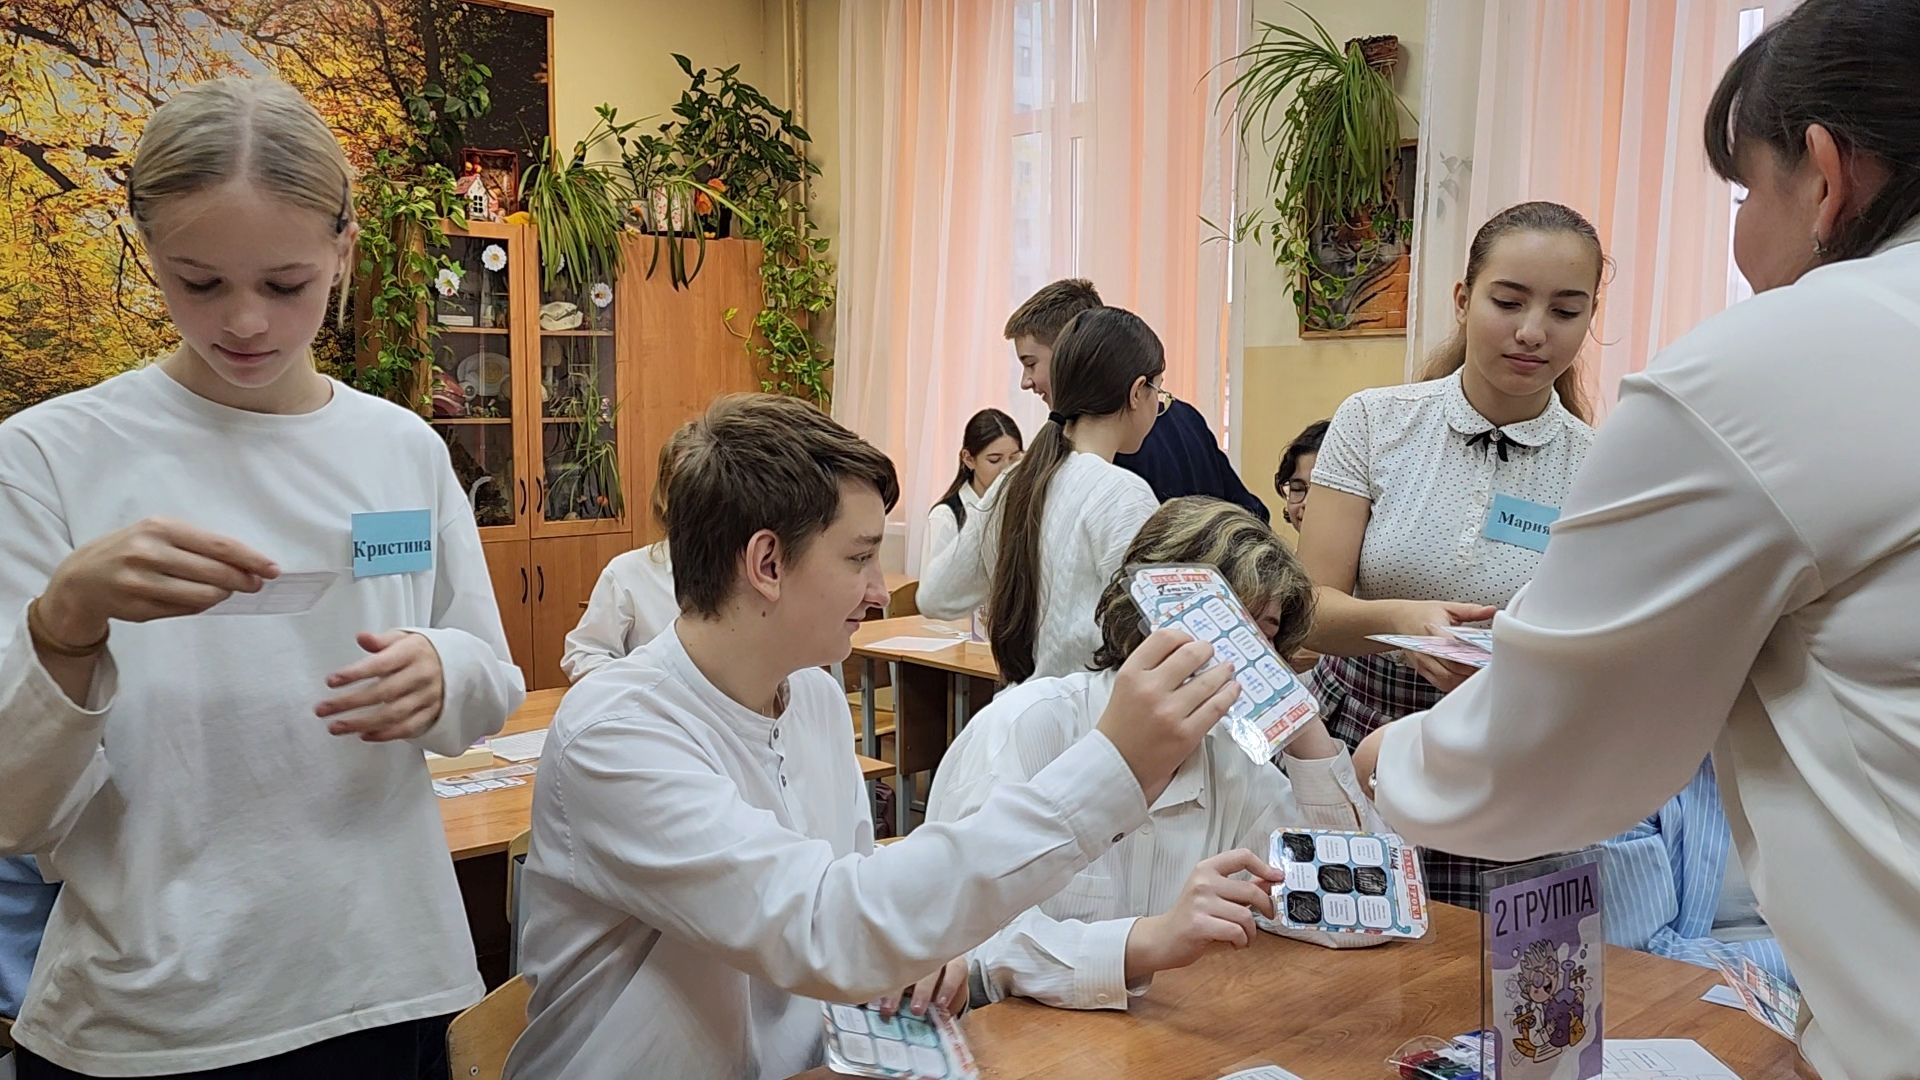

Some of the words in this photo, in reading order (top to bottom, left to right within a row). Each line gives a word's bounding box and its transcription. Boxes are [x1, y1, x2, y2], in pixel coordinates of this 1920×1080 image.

[1498, 511, 1551, 535] Мария
[353, 539, 432, 562] Кристина
[1494, 899, 1508, 937] 2
[1513, 875, 1594, 931] ГРУППА
